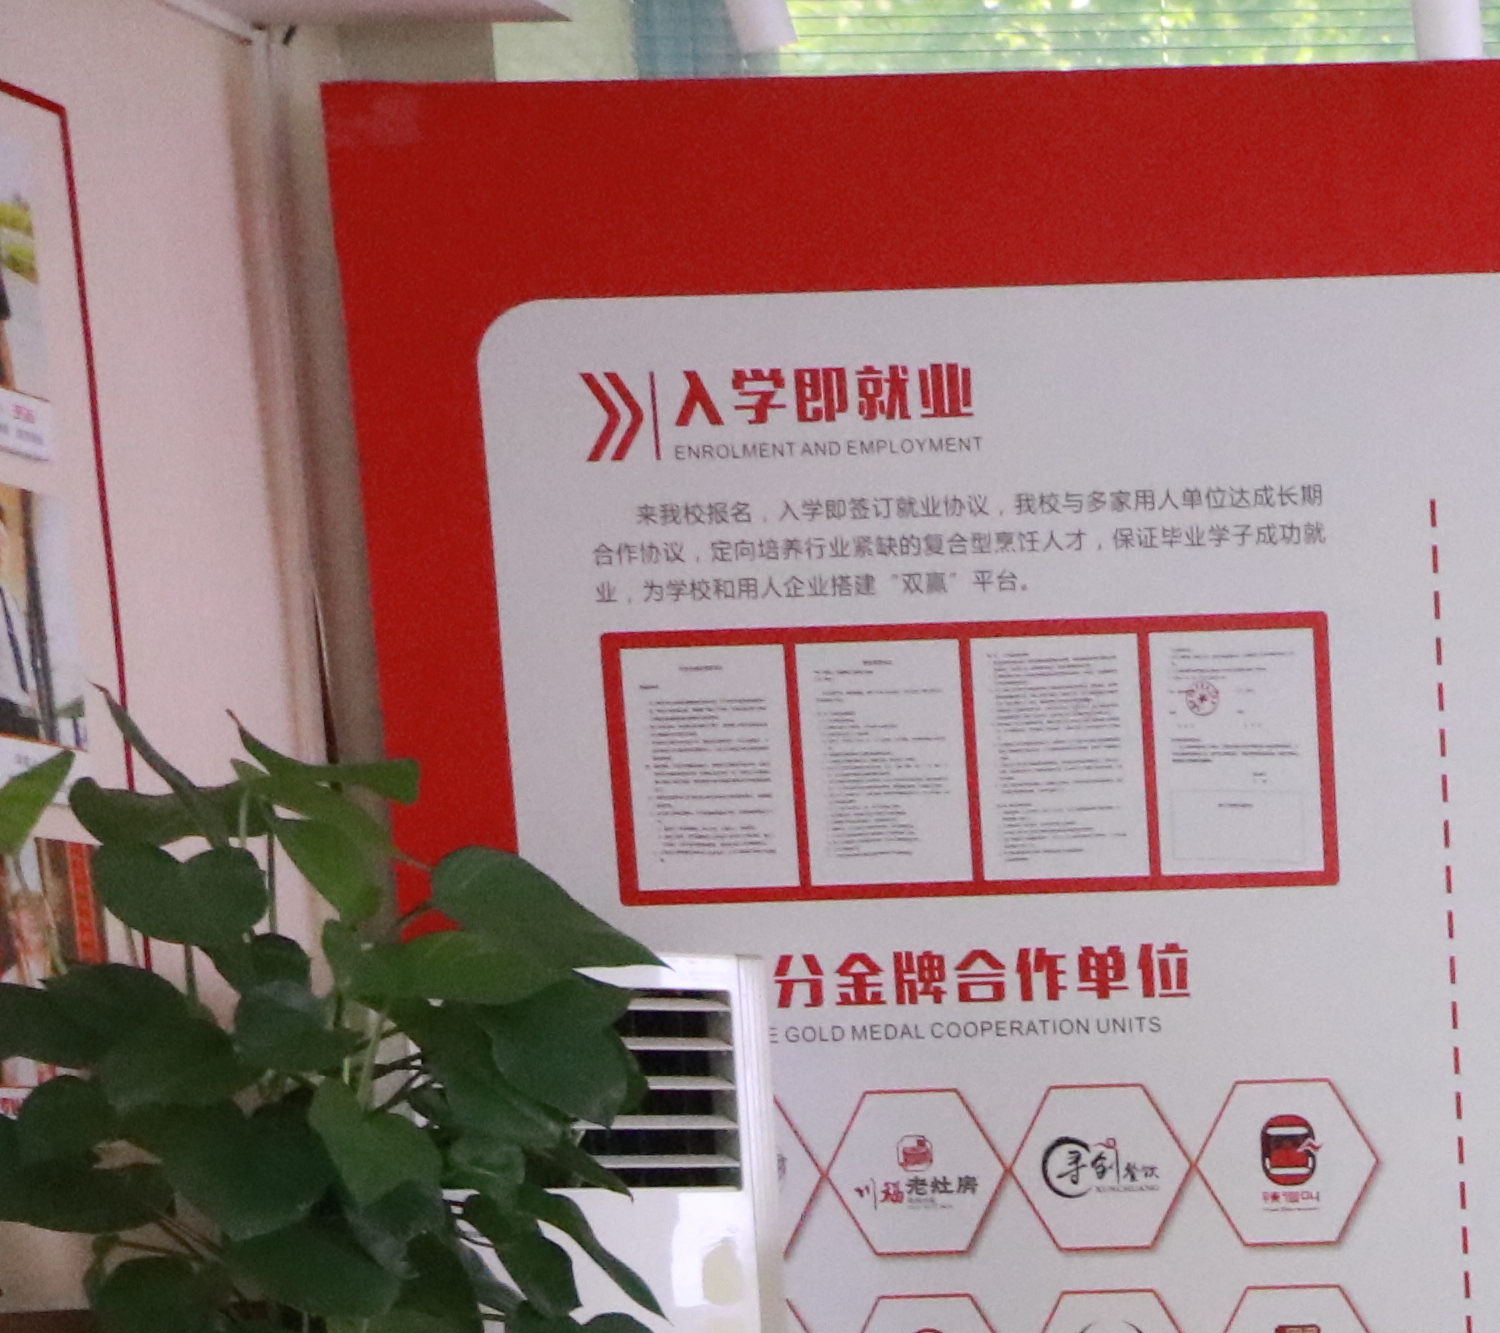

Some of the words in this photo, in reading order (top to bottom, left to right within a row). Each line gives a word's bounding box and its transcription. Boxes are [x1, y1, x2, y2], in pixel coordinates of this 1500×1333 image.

[675, 363, 973, 426] 入学即就业
[675, 442, 795, 460] ENROLMENT
[801, 441, 841, 456] AND
[847, 436, 982, 455] EMPLOYMENT
[785, 1025, 845, 1043] GOLD
[851, 1024, 925, 1041] MEDAL
[931, 1019, 1090, 1039] COOPERATION
[1096, 1016, 1161, 1034] UNITS
